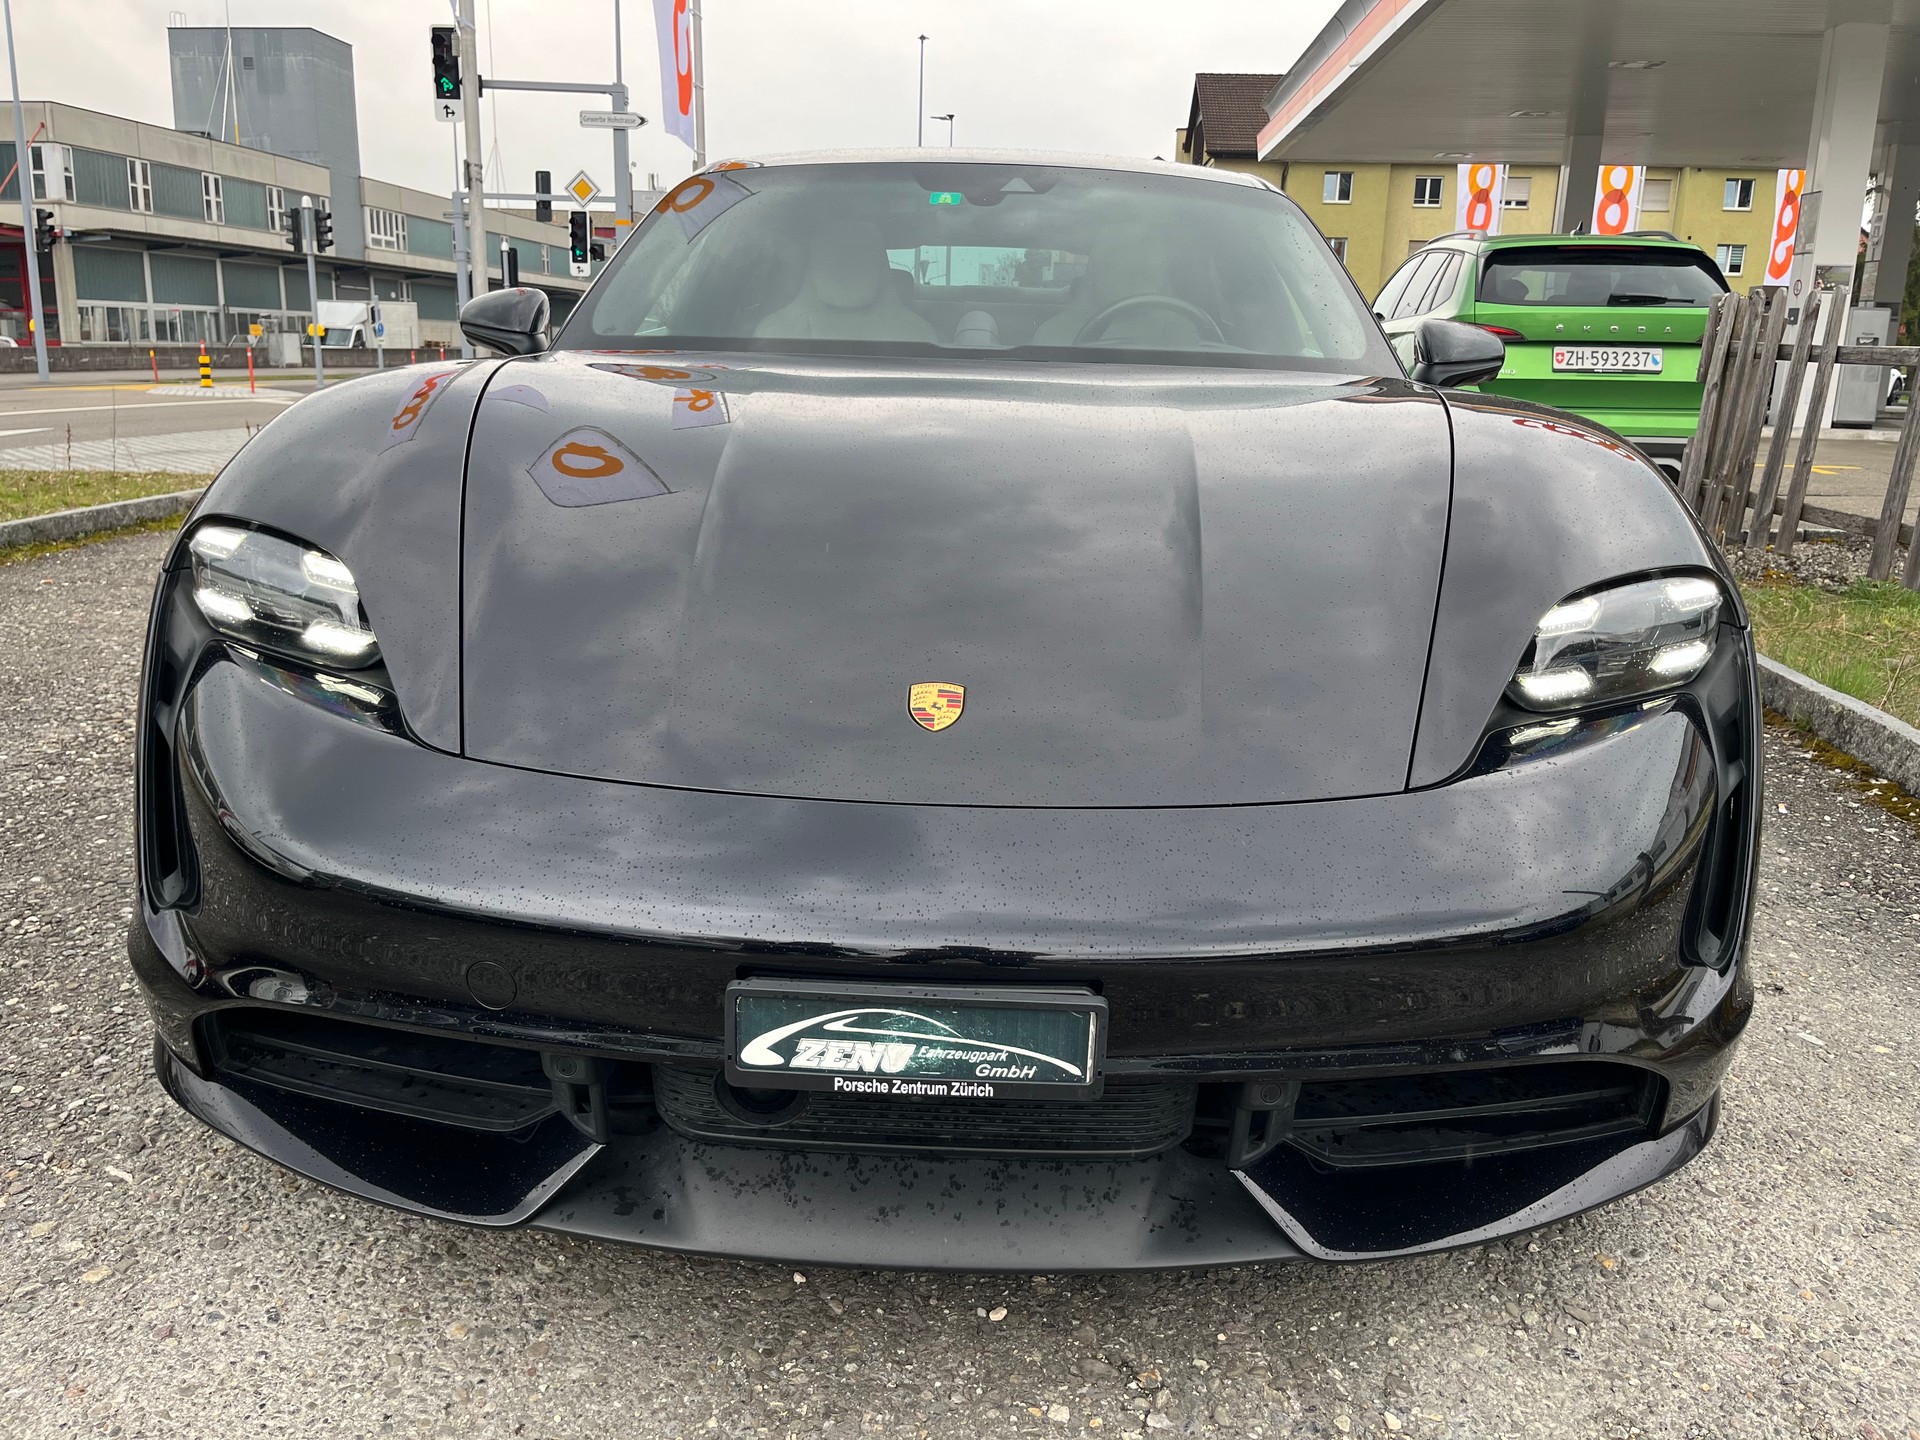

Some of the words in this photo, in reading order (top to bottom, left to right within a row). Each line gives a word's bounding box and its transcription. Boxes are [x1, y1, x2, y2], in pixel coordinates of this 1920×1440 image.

[582, 115, 606, 123] Gewerbe
[918, 1046, 1008, 1063] Fahrzeugpark
[975, 1063, 1038, 1079] GmbH
[834, 1077, 889, 1093] Porsche
[891, 1079, 948, 1095] Zentrum
[950, 1081, 994, 1097] Zürich
